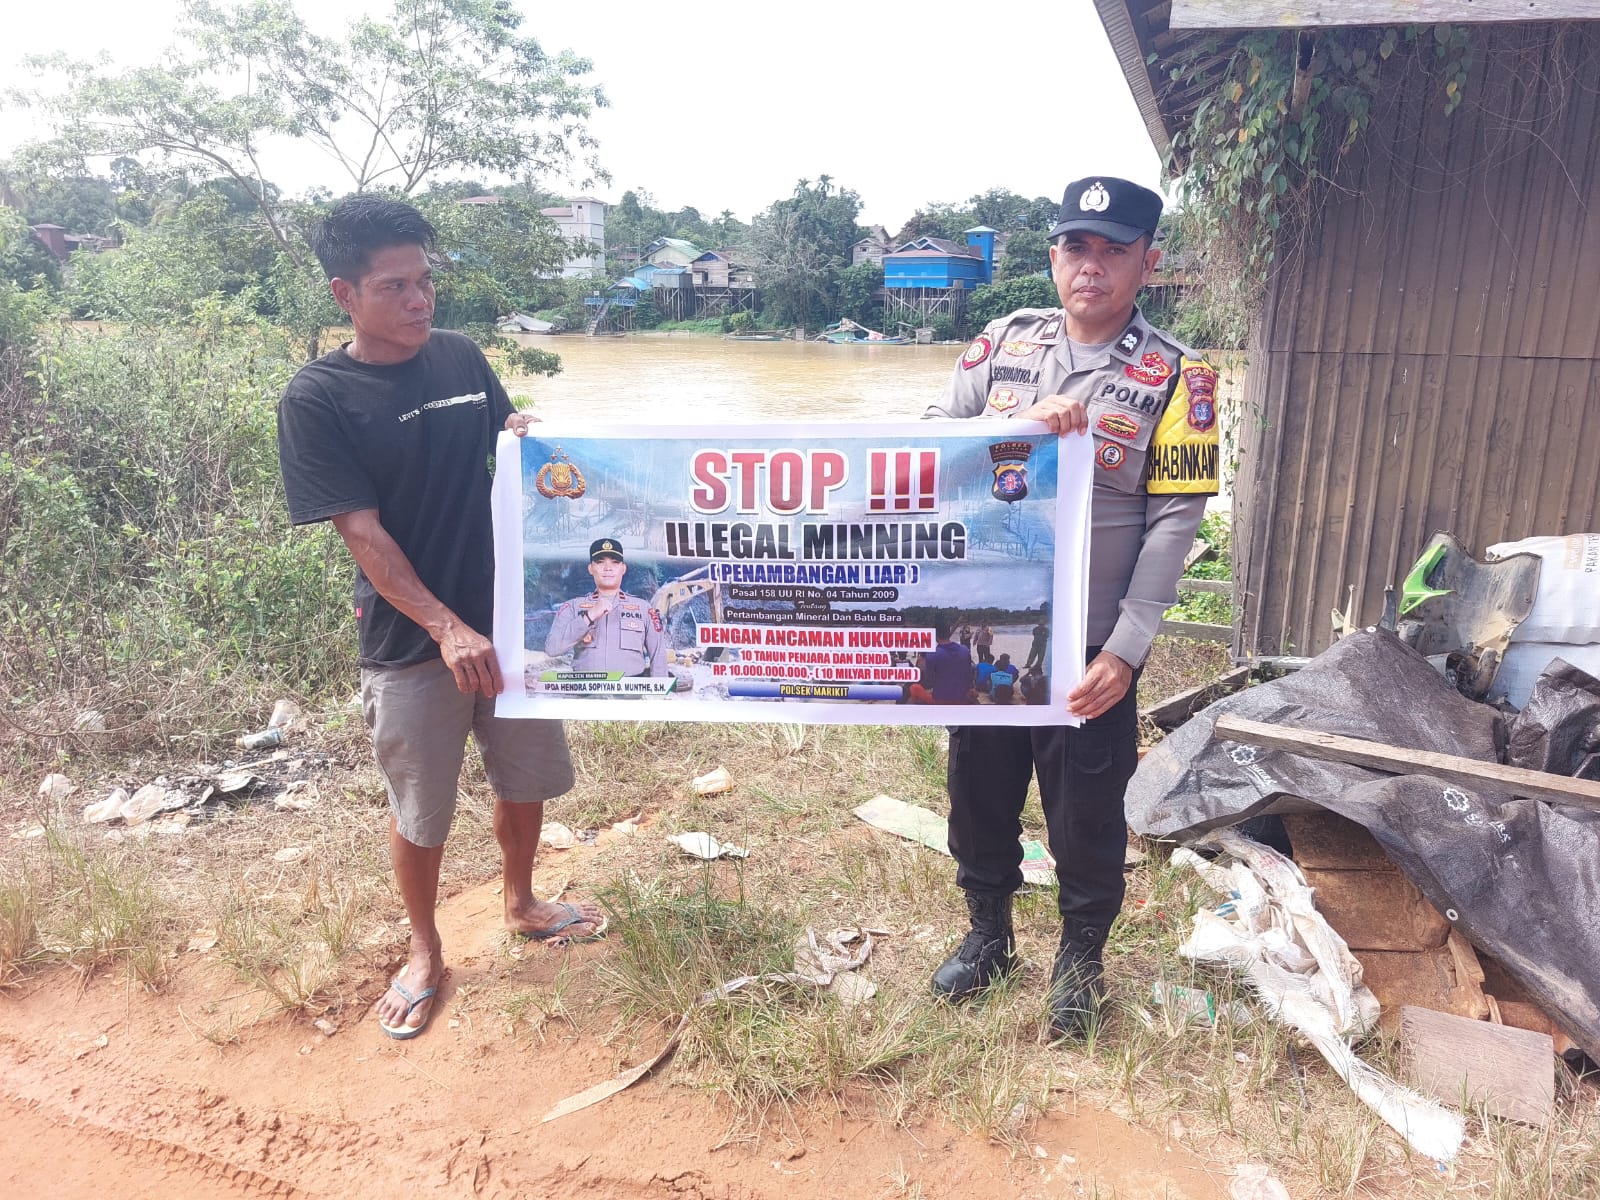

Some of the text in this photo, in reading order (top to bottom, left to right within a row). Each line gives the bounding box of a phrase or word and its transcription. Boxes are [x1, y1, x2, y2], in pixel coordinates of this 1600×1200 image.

[1100, 382, 1163, 415] POLRI
[398, 409, 420, 422] LEVI'S
[691, 450, 938, 512] STOP !!!
[665, 522, 967, 560] ILLEGAL MINNING
[732, 588, 757, 597] Pasal
[760, 589, 776, 597] 158
[796, 590, 805, 598] RI
[808, 590, 824, 598] No.
[840, 591, 869, 599] Tahun
[872, 591, 895, 599] 2009
[727, 611, 793, 622] Pertambangan
[796, 612, 830, 621] Mineral
[833, 613, 852, 621] Dan
[880, 614, 902, 622] Bara
[700, 628, 932, 649] DENGAN ANCAMAN HUKUMAN
[741, 650, 889, 665] 10 TAHUN PENJARA DAN DENDA
[713, 665, 728, 676] RP.
[836, 668, 871, 679] MILYAR
[561, 683, 587, 691] HENDRA
[588, 682, 615, 691] SOPIYAN
[625, 683, 653, 693] MUNTHE,
[654, 683, 667, 692] S.H.
[780, 685, 849, 697] POLSEK MARIKIT
